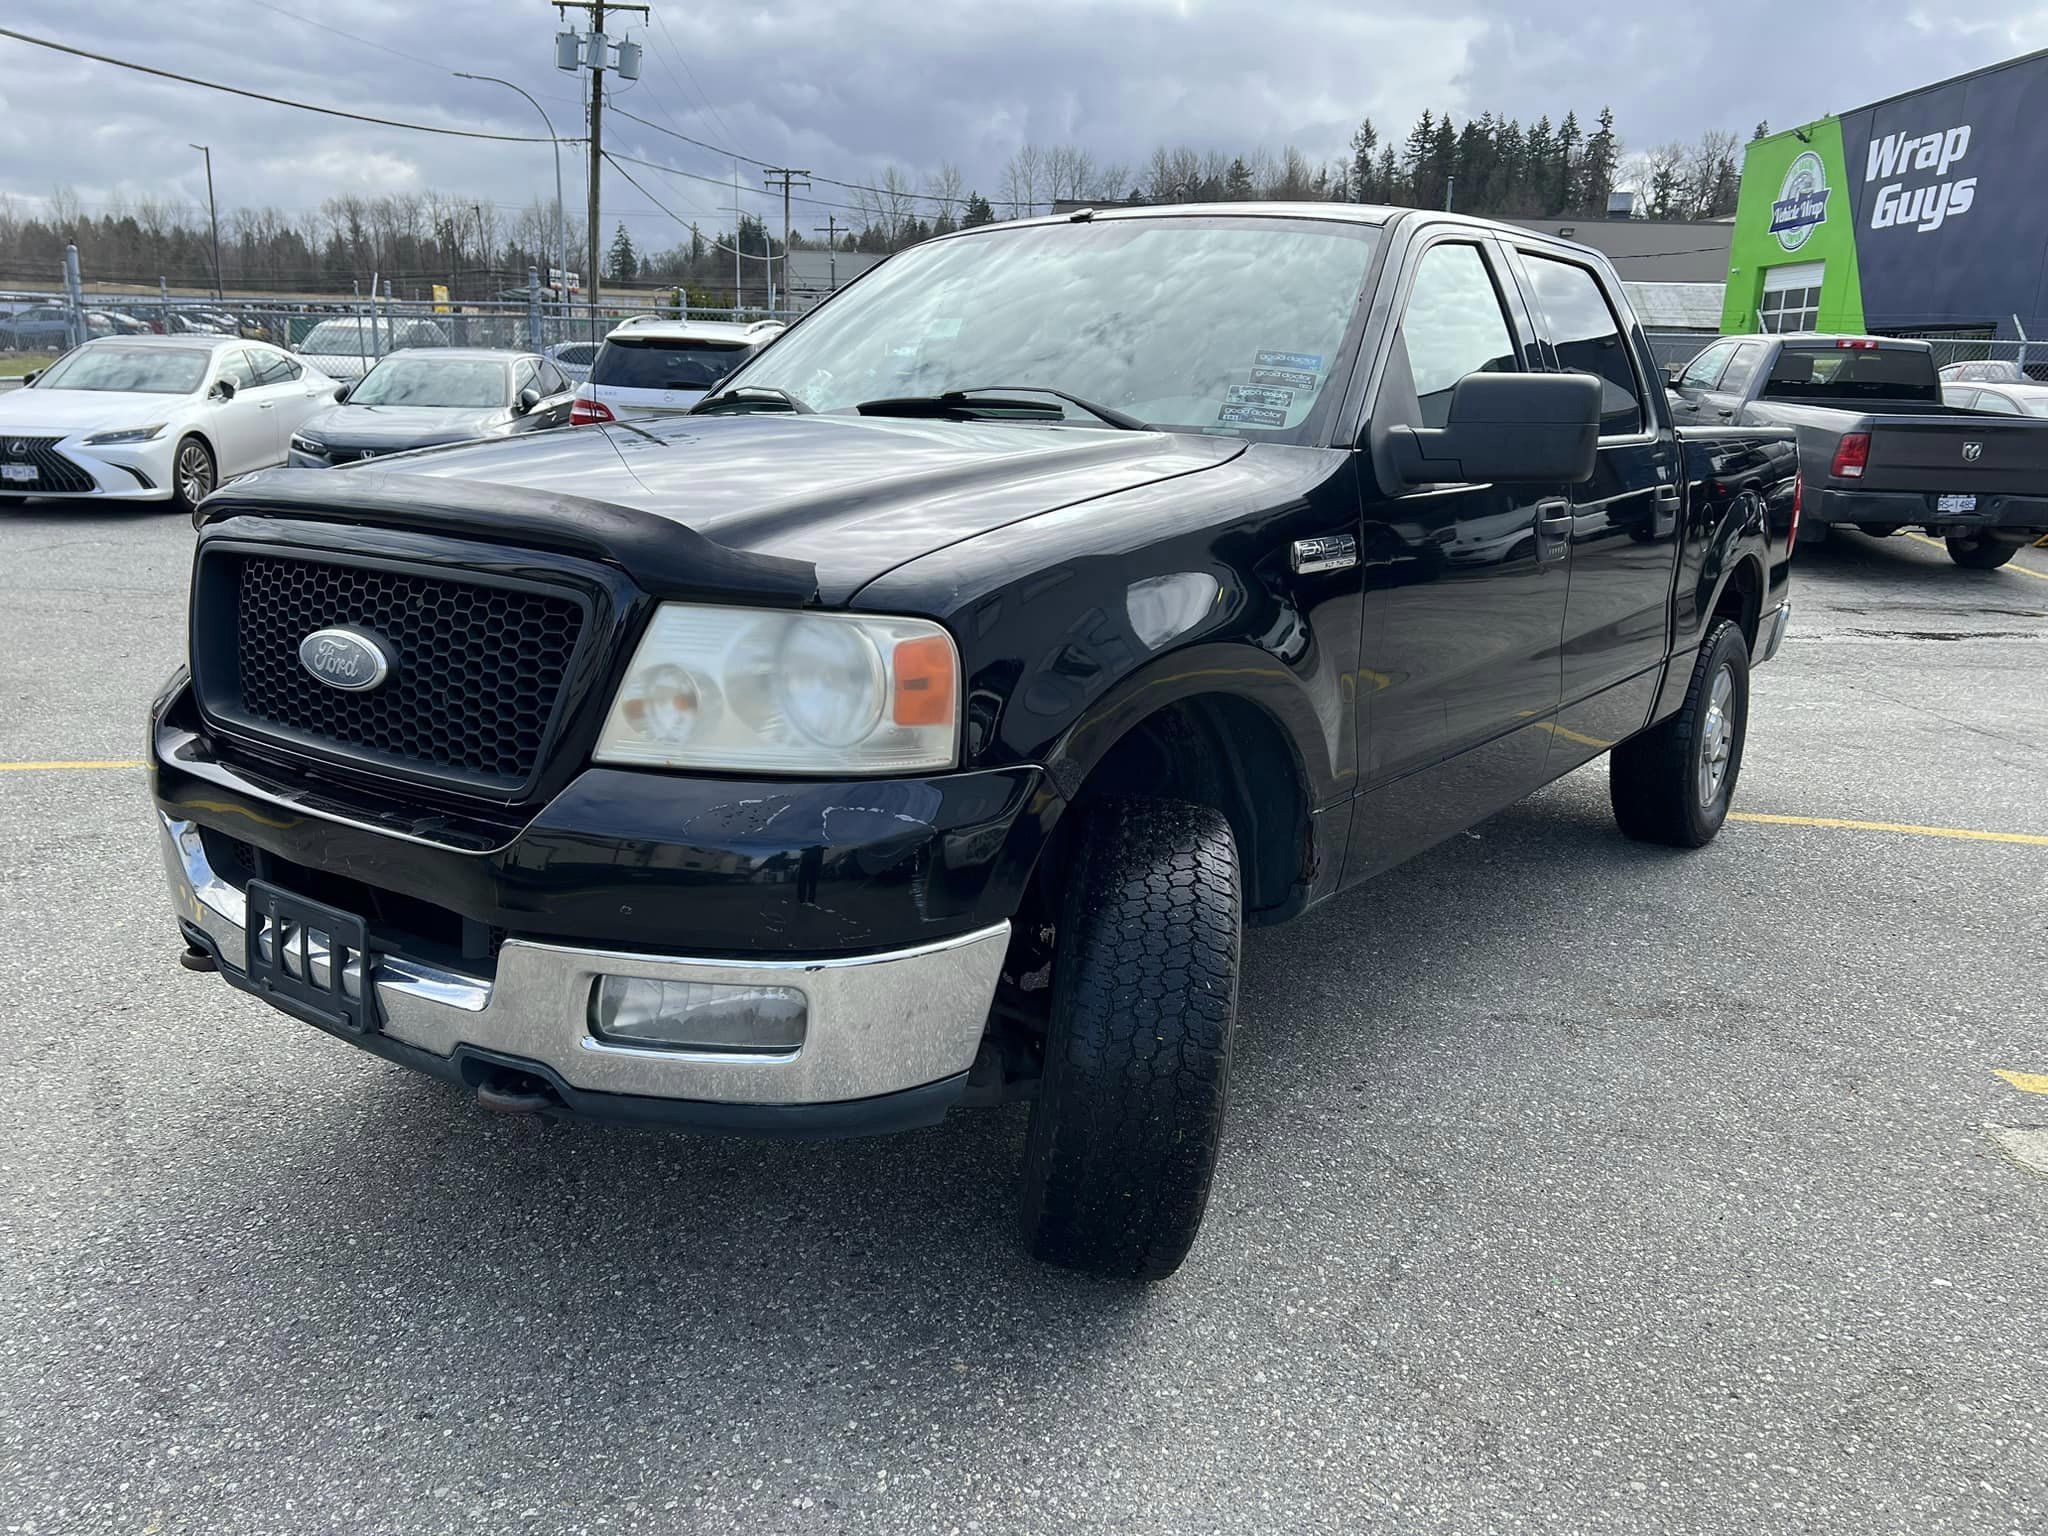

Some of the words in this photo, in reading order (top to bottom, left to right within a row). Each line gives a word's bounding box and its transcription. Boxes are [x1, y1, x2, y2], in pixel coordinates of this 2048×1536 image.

[1865, 124, 1972, 182] Wrap
[1774, 204, 1800, 224] Vehicle
[1801, 199, 1824, 219] Wrap
[1870, 177, 1977, 232] Guys
[1224, 407, 1250, 415] good
[1250, 409, 1282, 418] doctor
[313, 639, 359, 677] Ford
